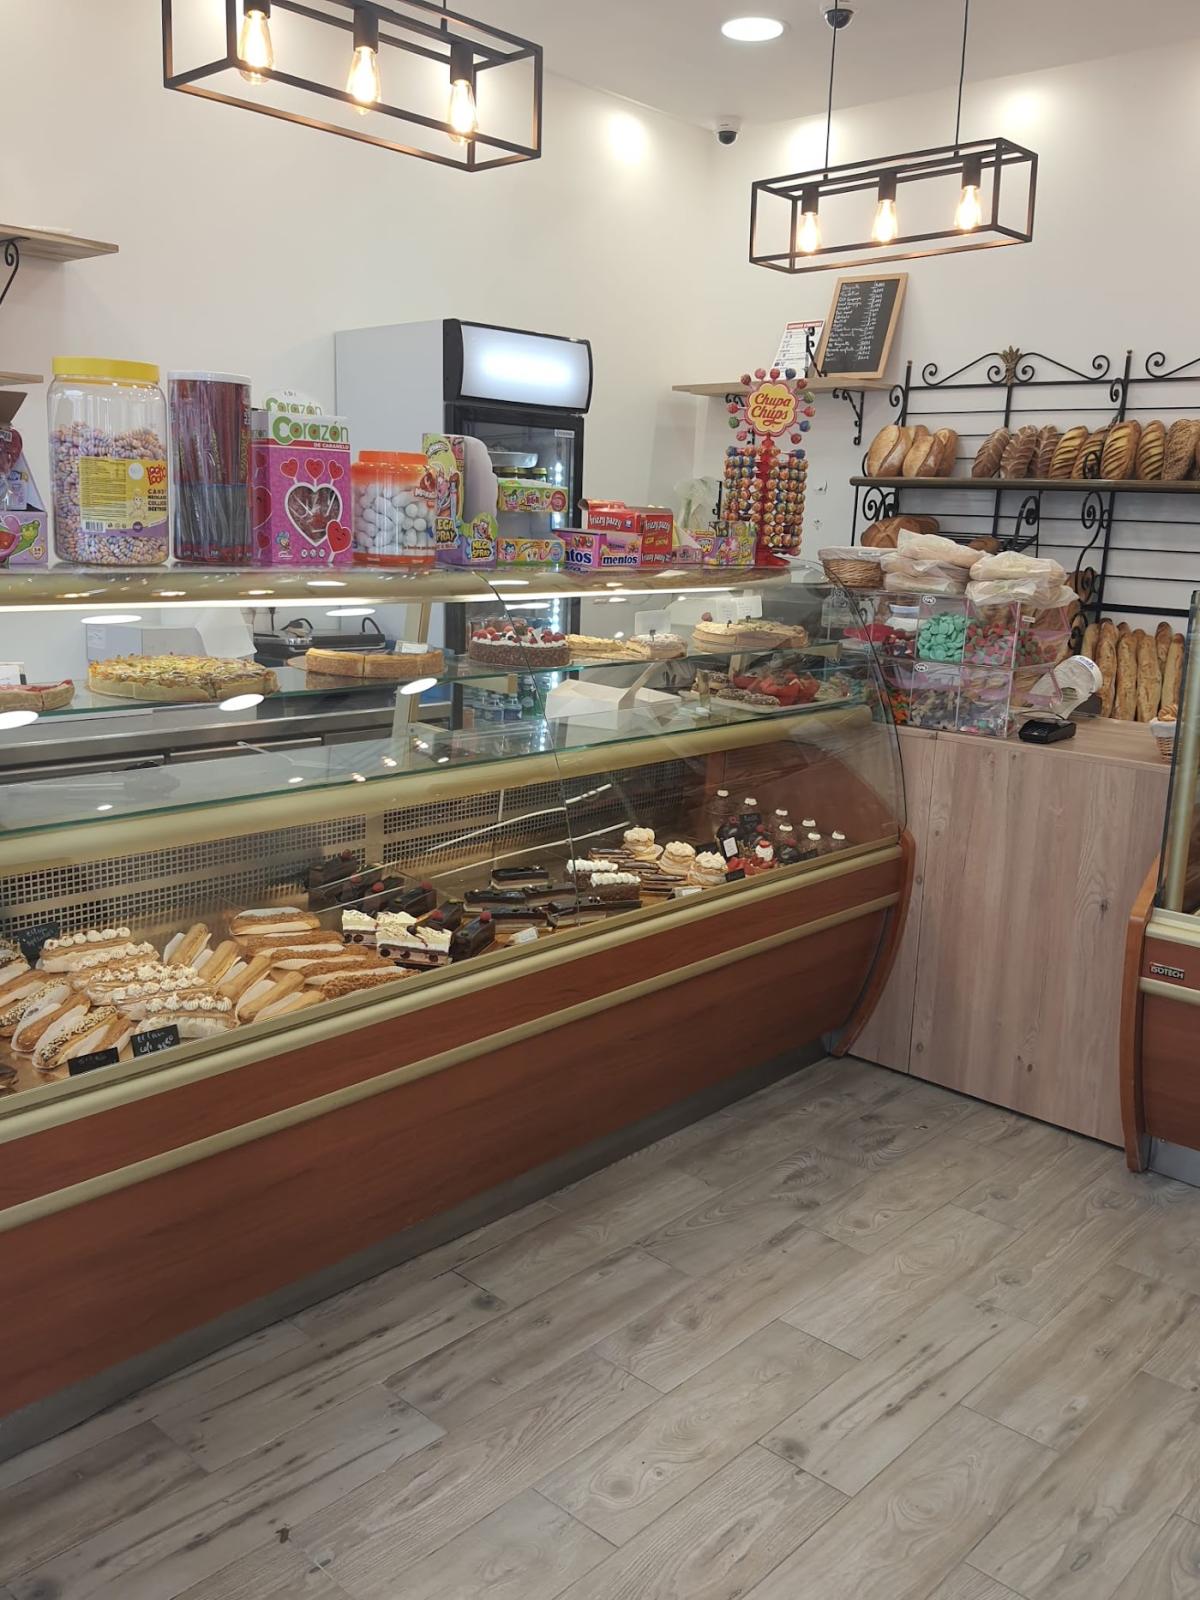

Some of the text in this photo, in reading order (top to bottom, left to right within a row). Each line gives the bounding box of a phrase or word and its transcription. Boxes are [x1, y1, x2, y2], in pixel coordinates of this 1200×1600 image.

[754, 393, 792, 409] Chupa
[751, 406, 789, 426] Chups
[272, 416, 349, 445] Corazón
[436, 518, 454, 530] EGA
[436, 530, 455, 542] PRAY
[603, 556, 638, 564] mentos
